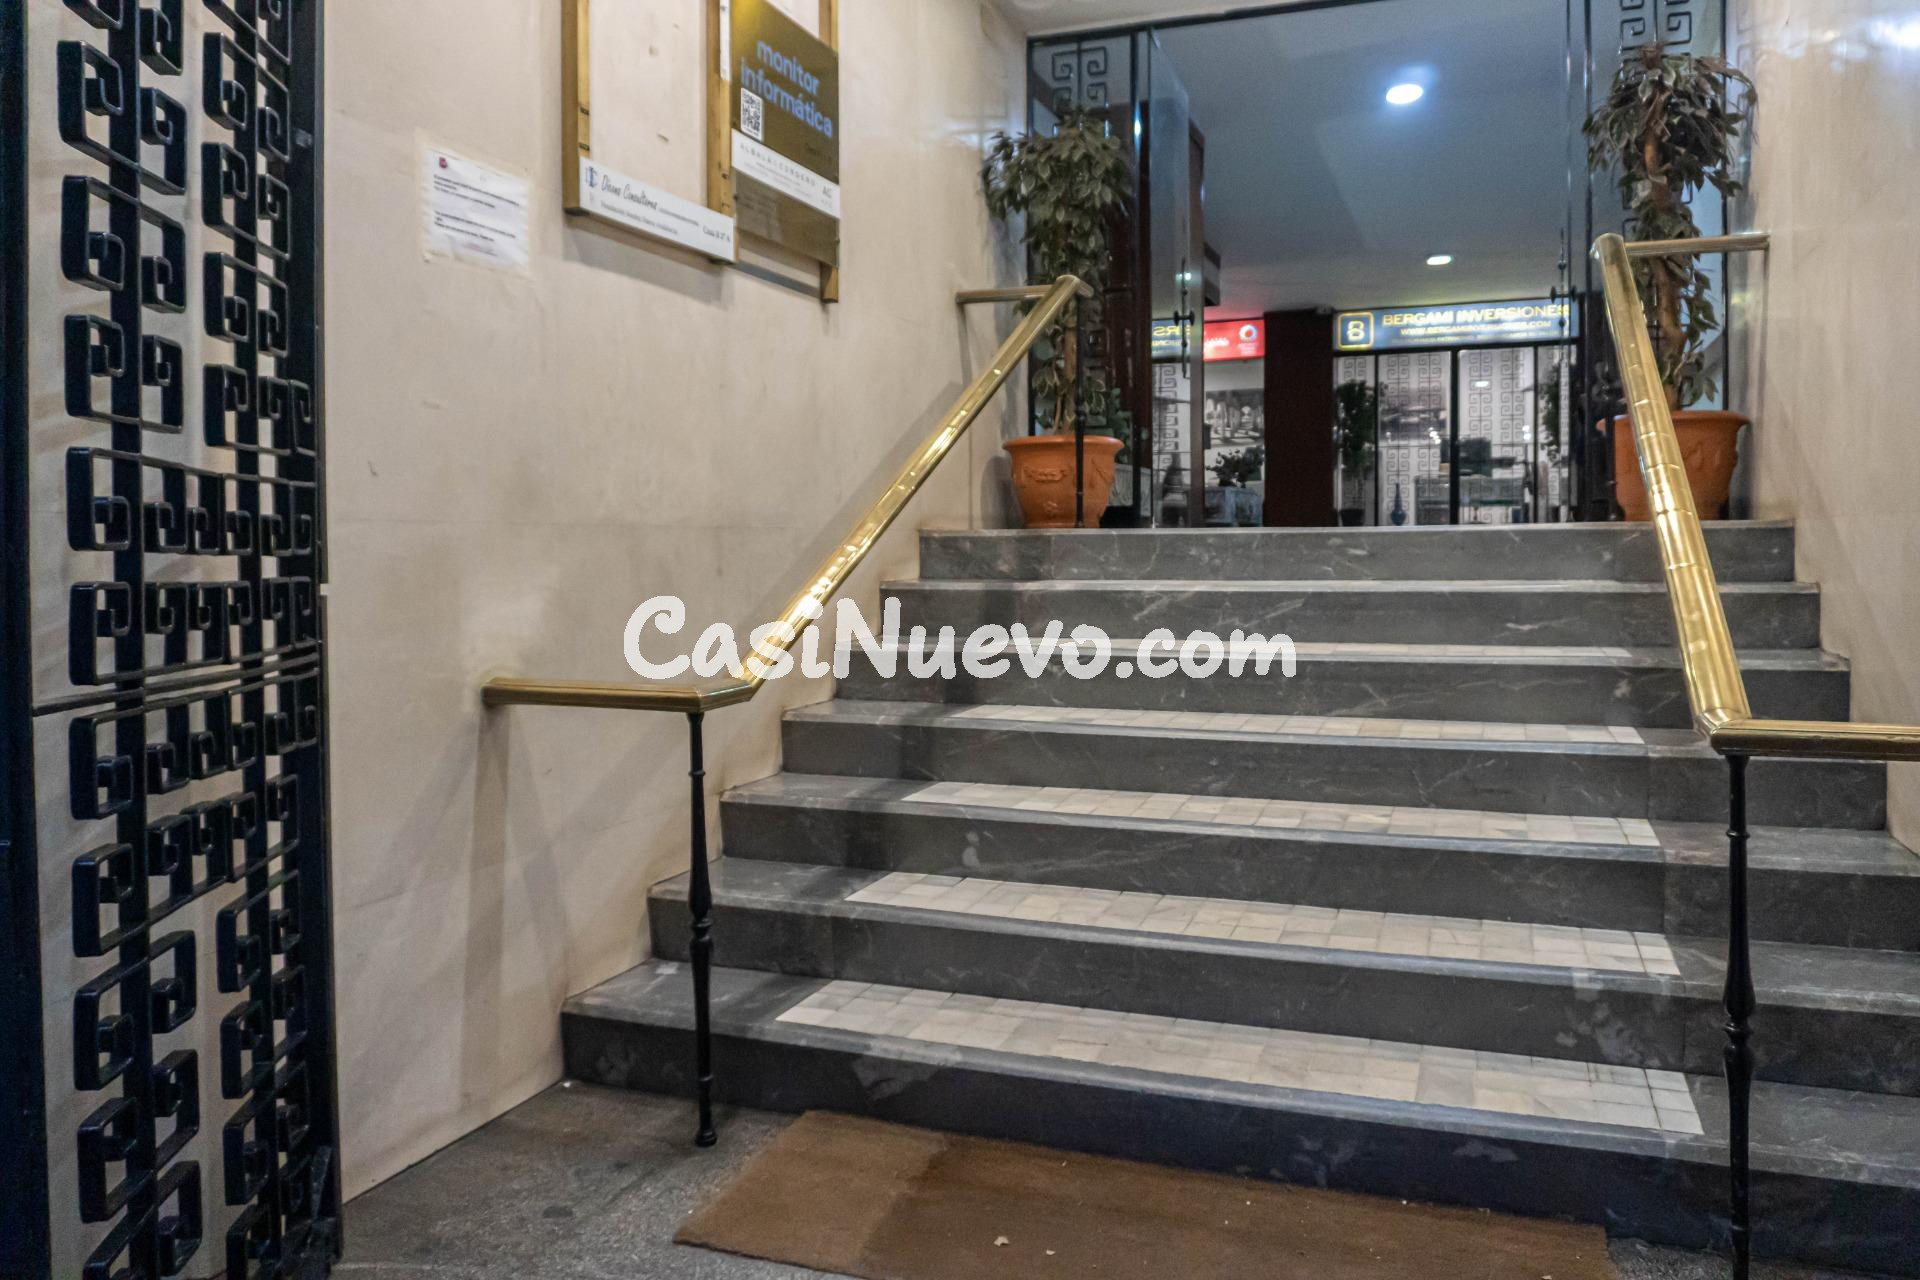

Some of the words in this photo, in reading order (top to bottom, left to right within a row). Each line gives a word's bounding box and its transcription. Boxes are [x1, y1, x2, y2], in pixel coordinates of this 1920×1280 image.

[757, 40, 819, 95] monitor
[741, 57, 833, 137] informática
[1382, 310, 1454, 328] BERGAMI
